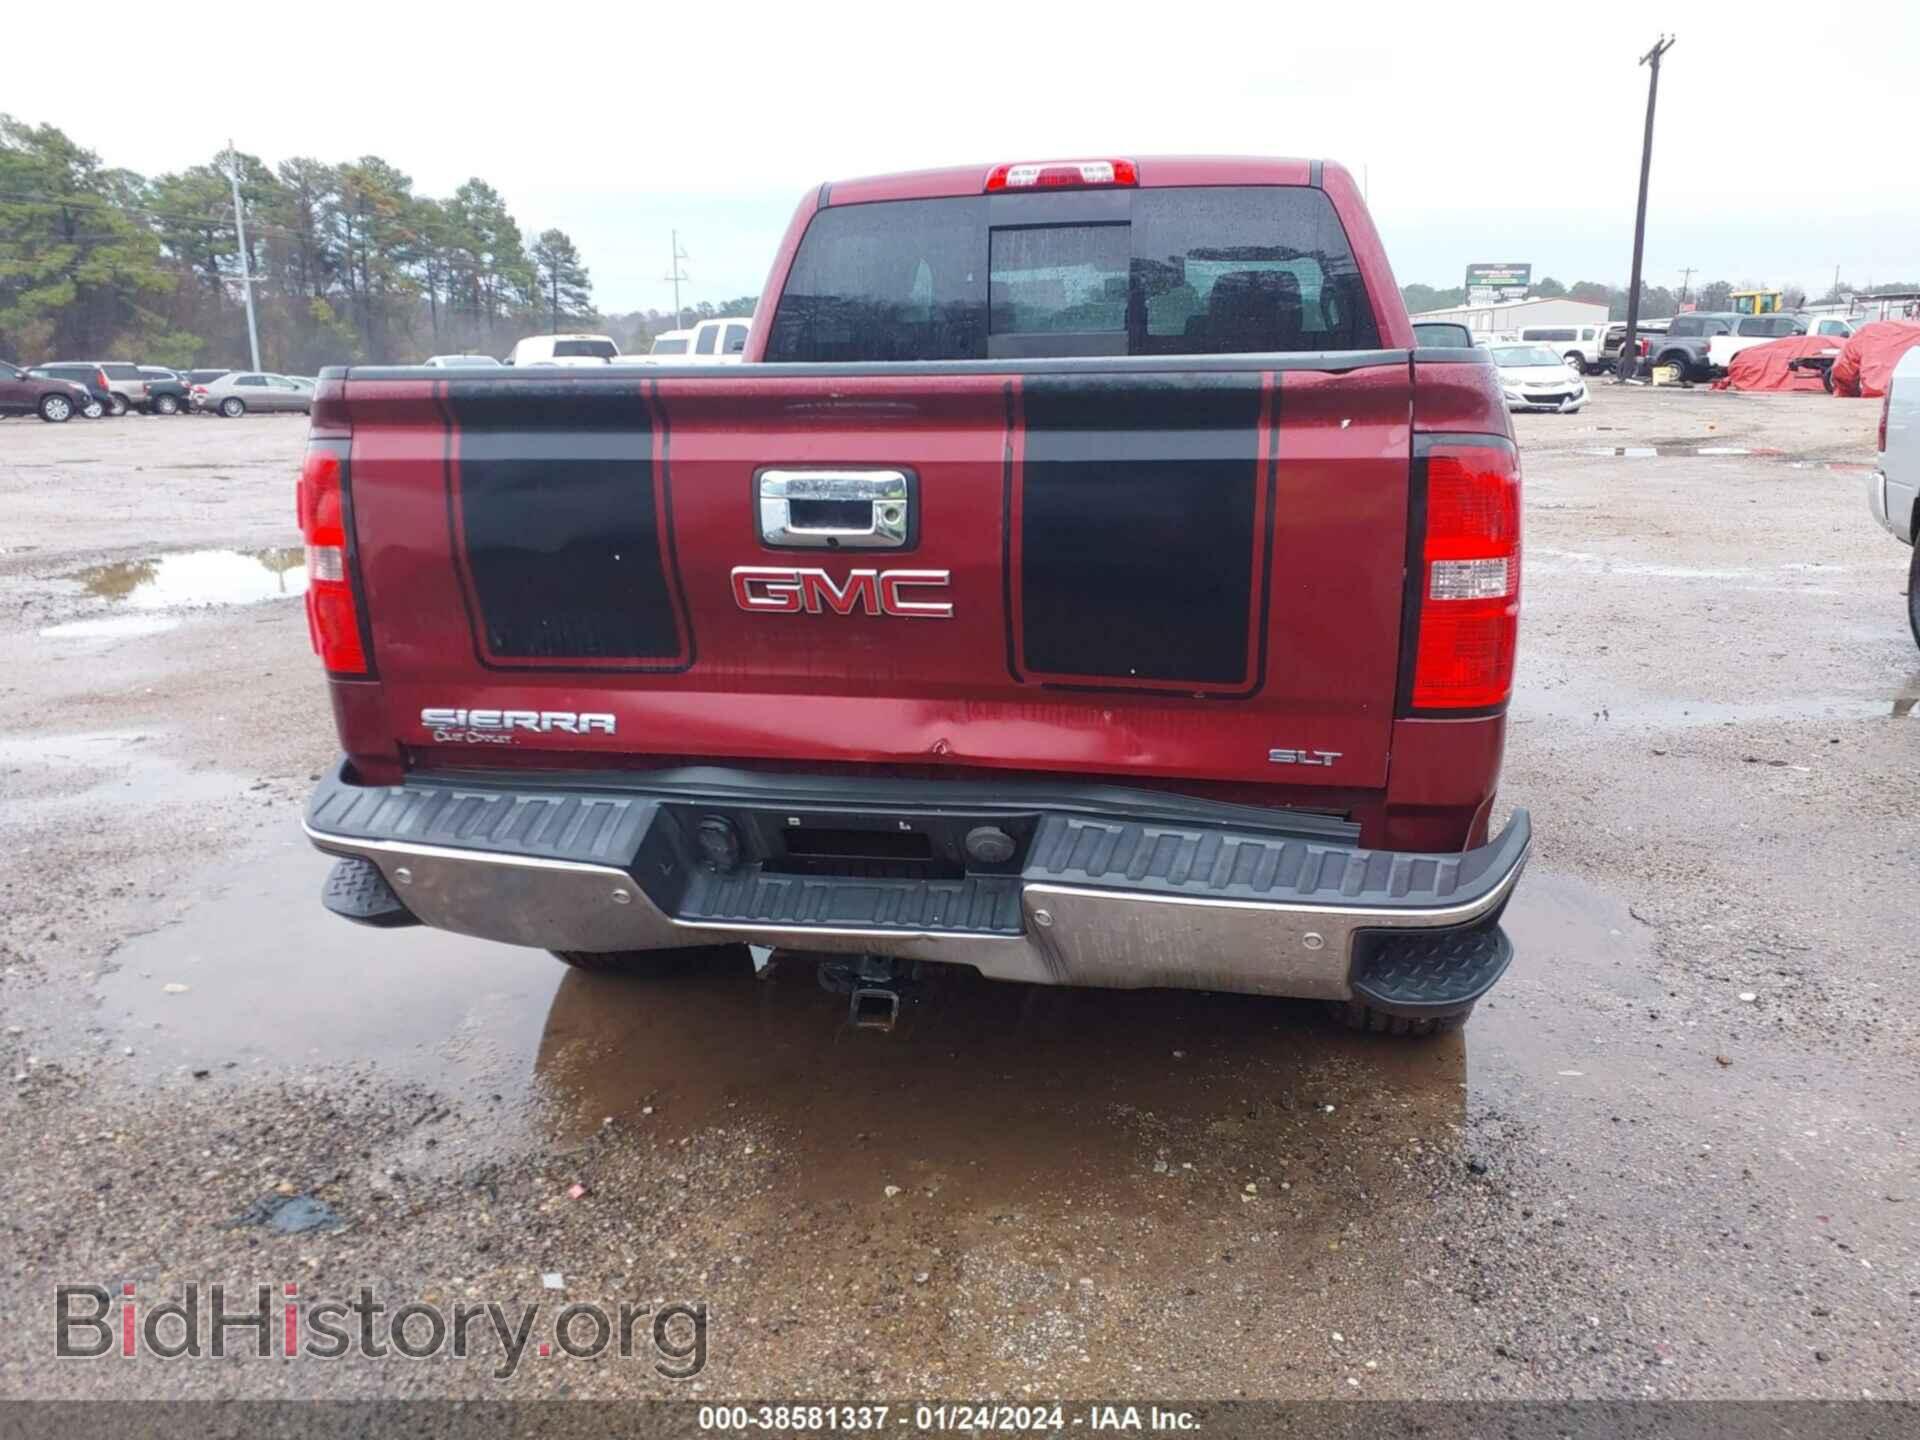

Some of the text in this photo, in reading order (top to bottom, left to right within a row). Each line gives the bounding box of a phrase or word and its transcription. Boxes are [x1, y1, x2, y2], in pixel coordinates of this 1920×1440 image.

[730, 566, 953, 618] GMC
[420, 707, 616, 734] SIERRA
[1268, 749, 1343, 766] SLT
